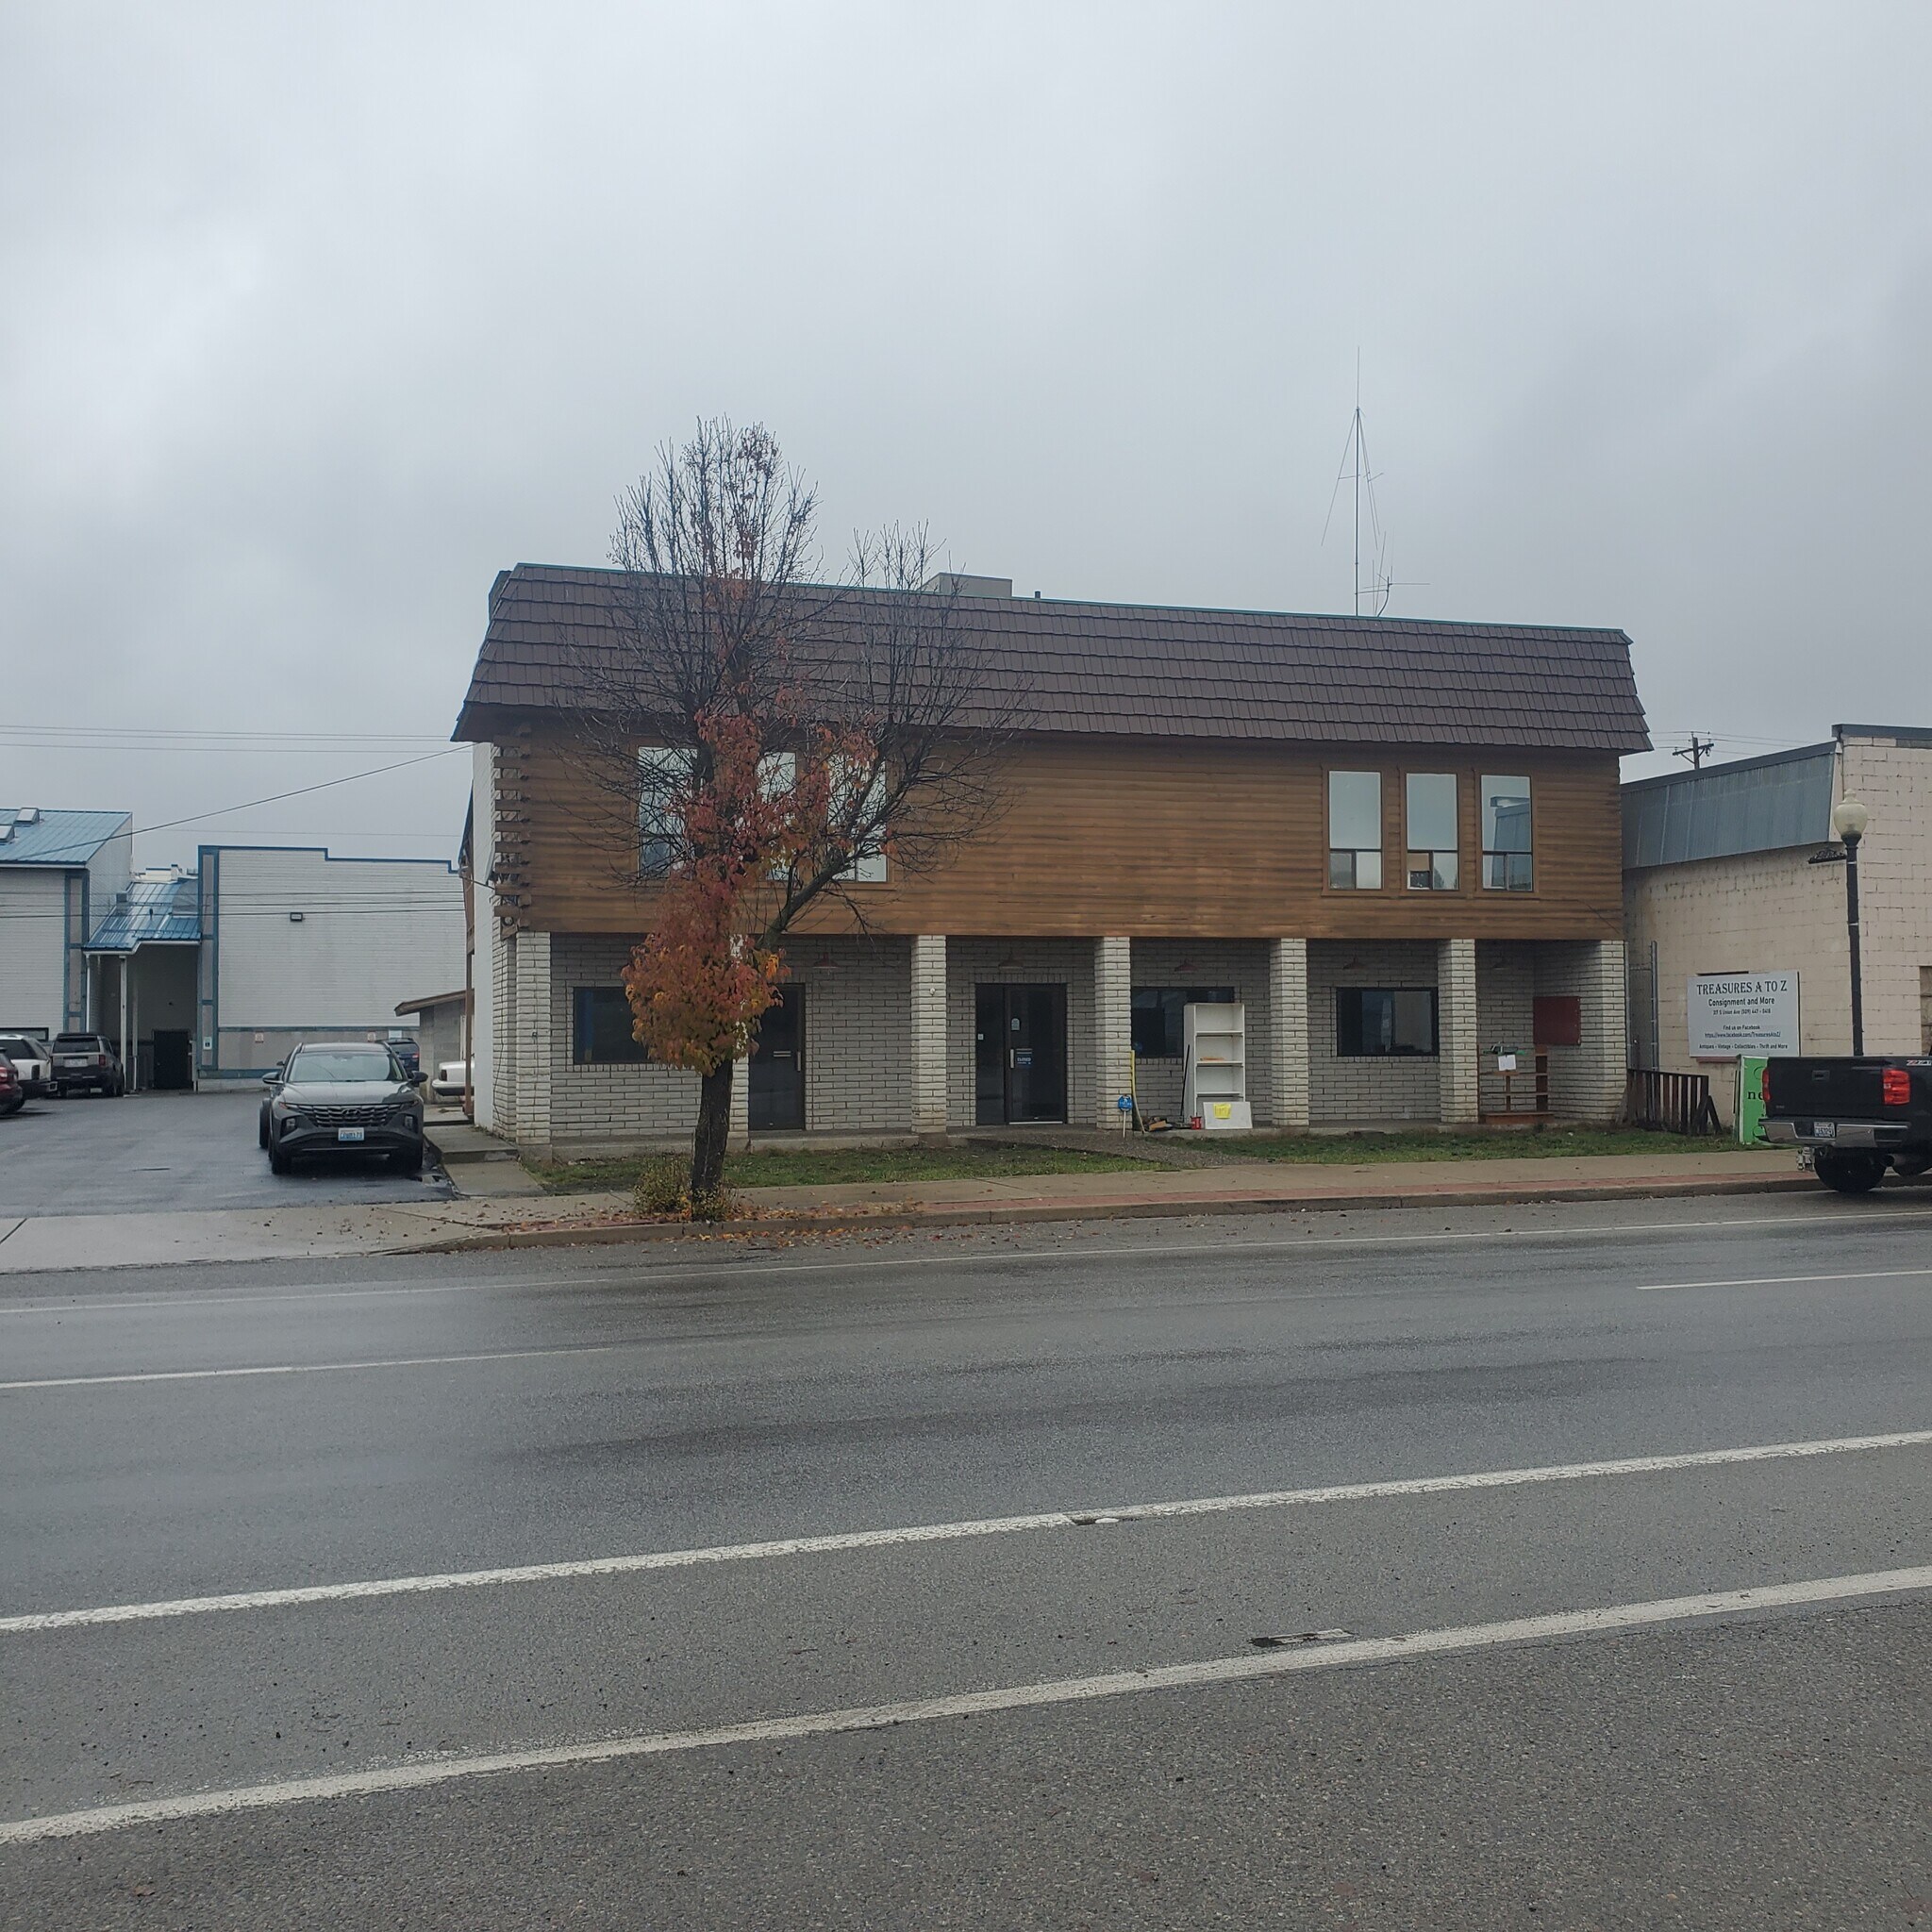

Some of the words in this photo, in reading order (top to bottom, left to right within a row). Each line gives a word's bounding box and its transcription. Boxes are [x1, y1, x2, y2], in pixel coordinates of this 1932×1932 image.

[1696, 982, 1753, 995] TREASURES
[1755, 981, 1762, 992] A
[1765, 980, 1777, 992] TO
[1780, 980, 1788, 991] Z
[1708, 998, 1746, 1008] Consignment
